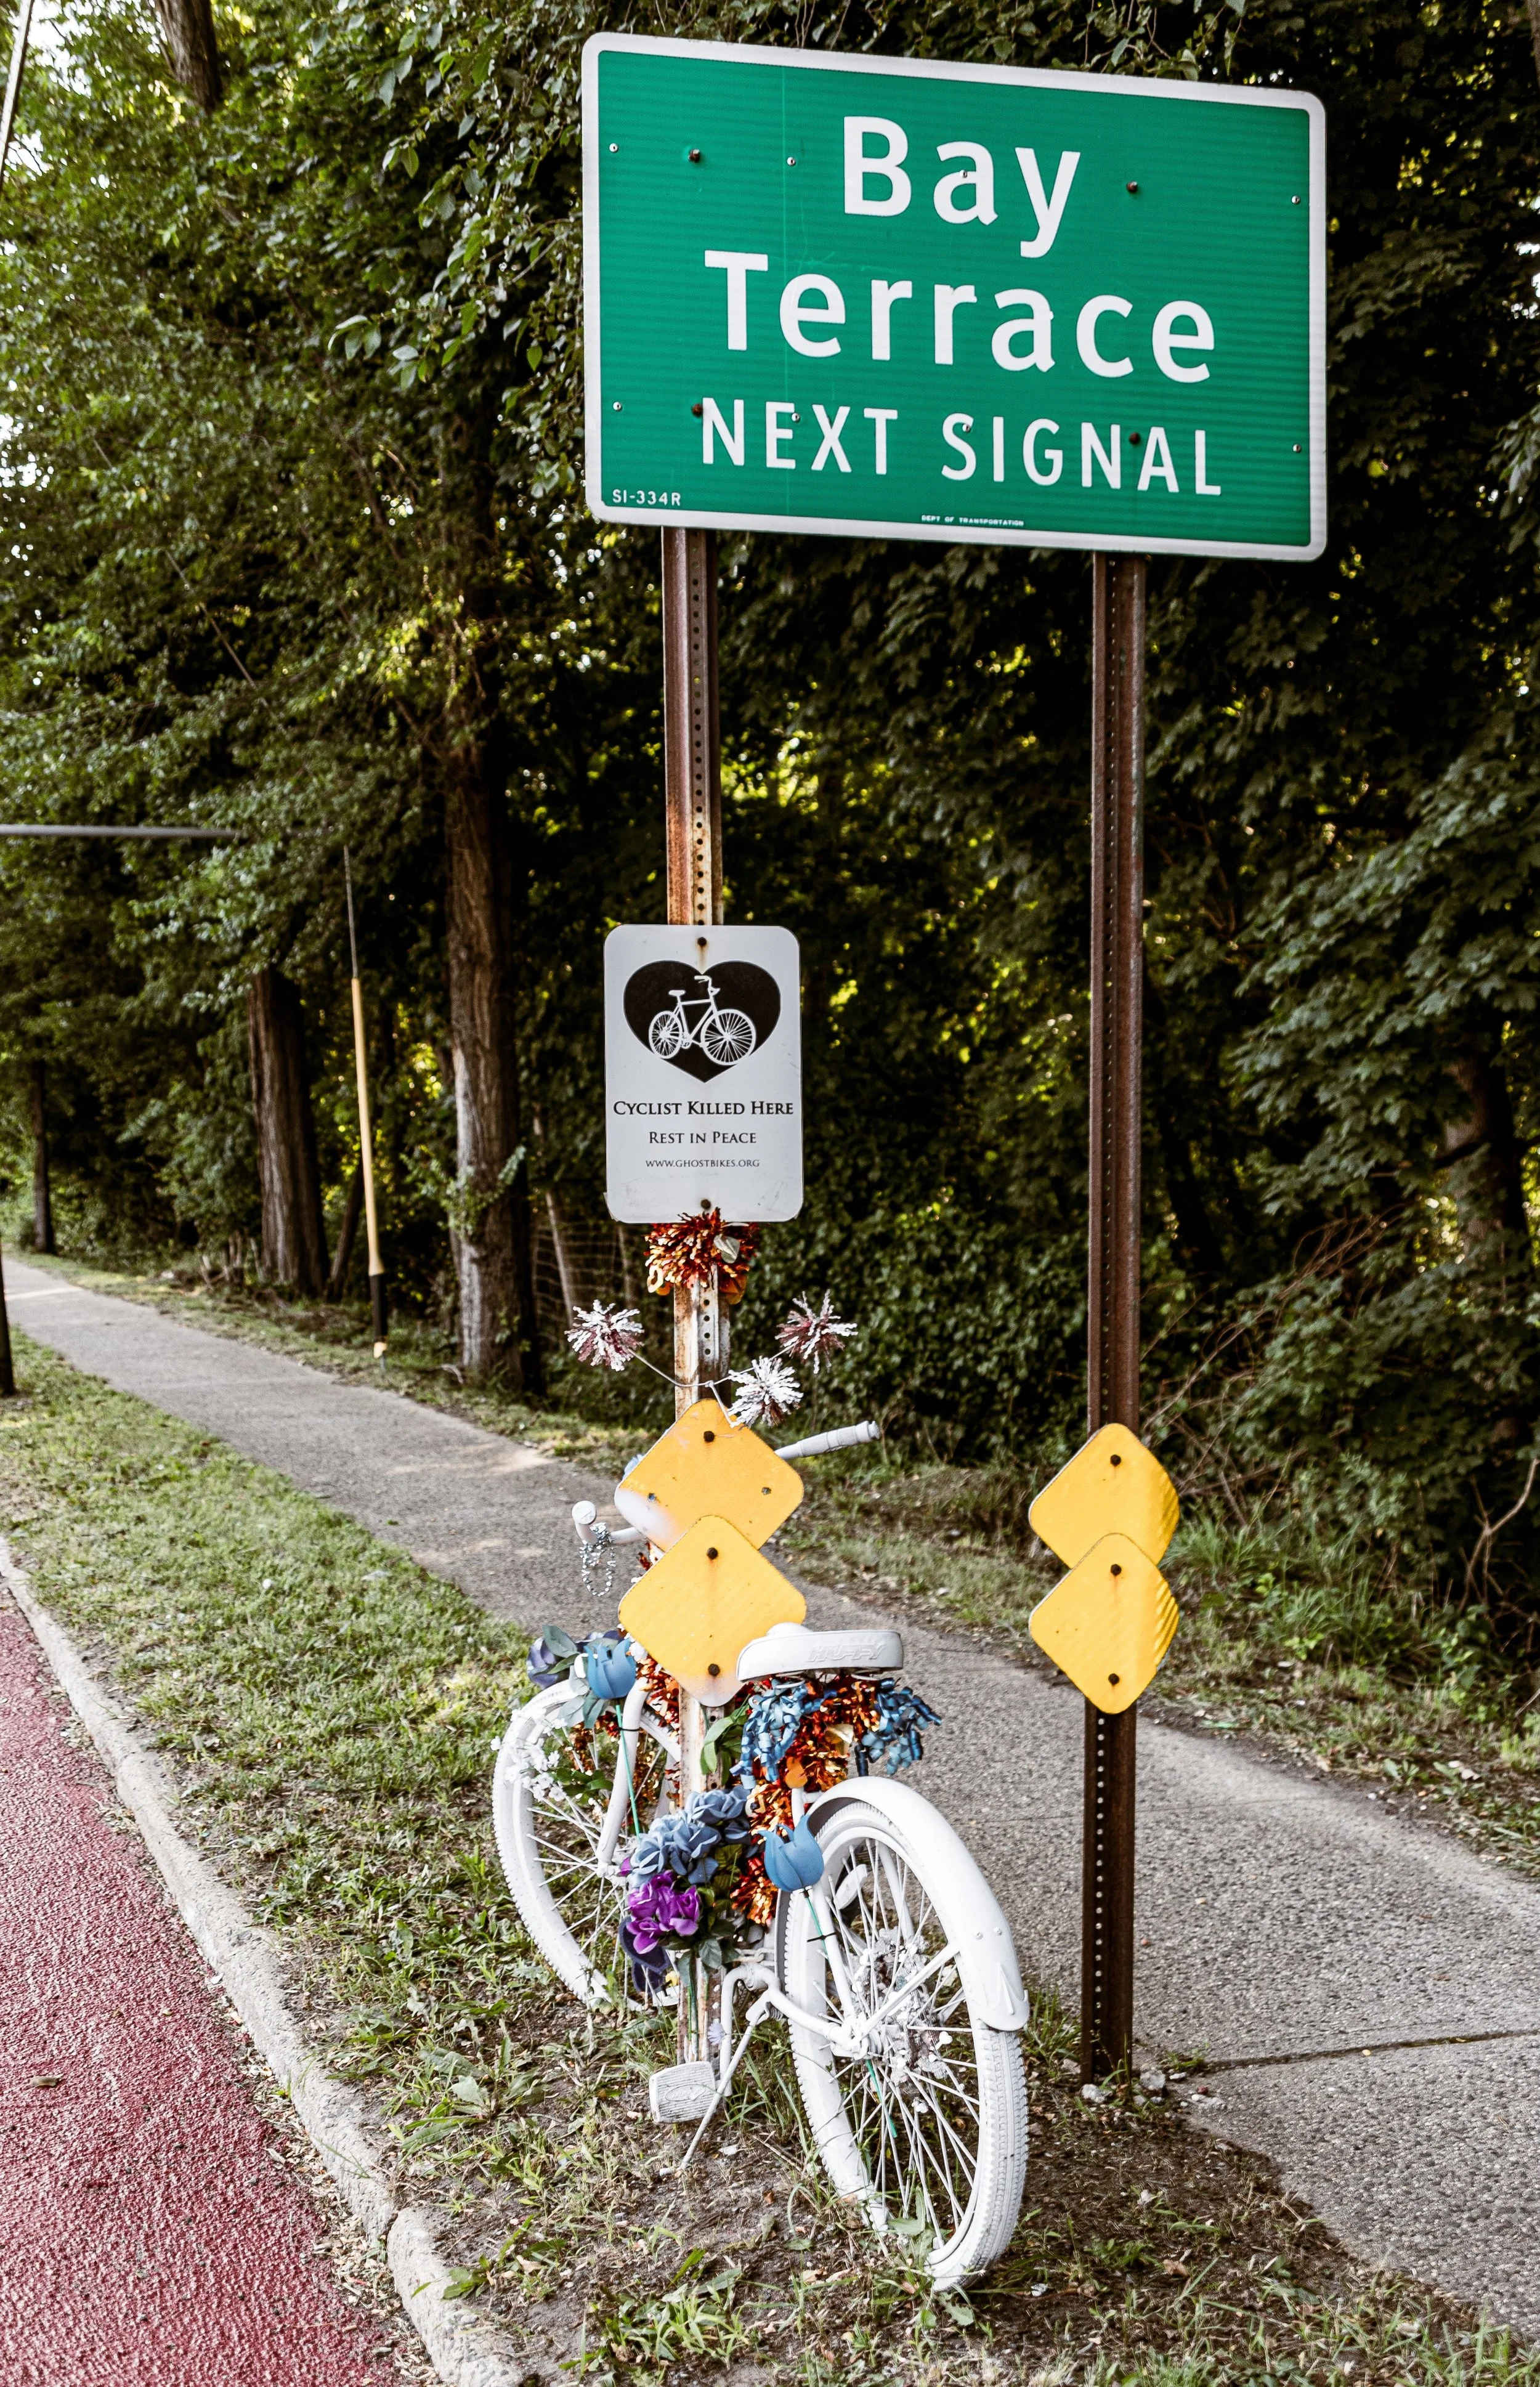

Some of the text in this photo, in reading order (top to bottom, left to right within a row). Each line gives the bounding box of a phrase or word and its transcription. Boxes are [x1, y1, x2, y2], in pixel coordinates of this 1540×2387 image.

[843, 116, 1081, 259] Bay
[704, 249, 1215, 383] Terrace
[702, 397, 1222, 496] NEXT SIGNAL
[612, 488, 681, 506] SI-334R
[921, 514, 1024, 527] DEPT OF TRANSPORTATION
[646, 1159, 760, 1168] WWW.GHOSTBIKES.ORG
